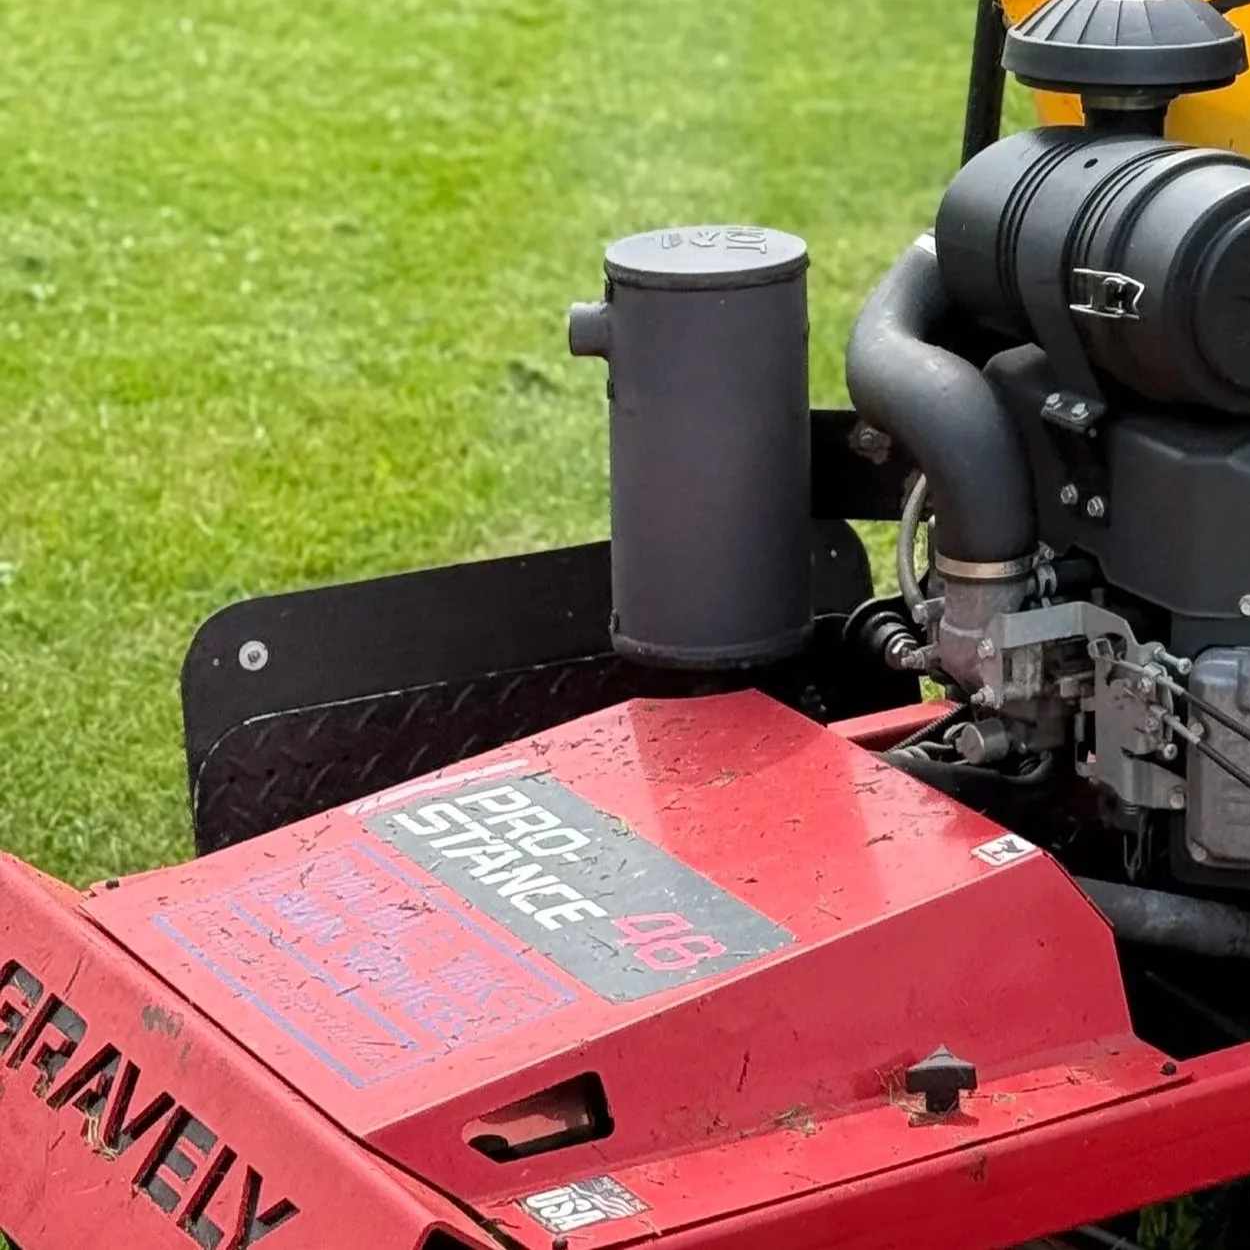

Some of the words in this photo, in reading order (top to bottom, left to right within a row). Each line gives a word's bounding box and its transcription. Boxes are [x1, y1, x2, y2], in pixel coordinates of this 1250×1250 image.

[454, 784, 592, 862] PRO-
[393, 801, 610, 931] STANCE
[610, 911, 728, 970] 48
[526, 1186, 606, 1232] USA
